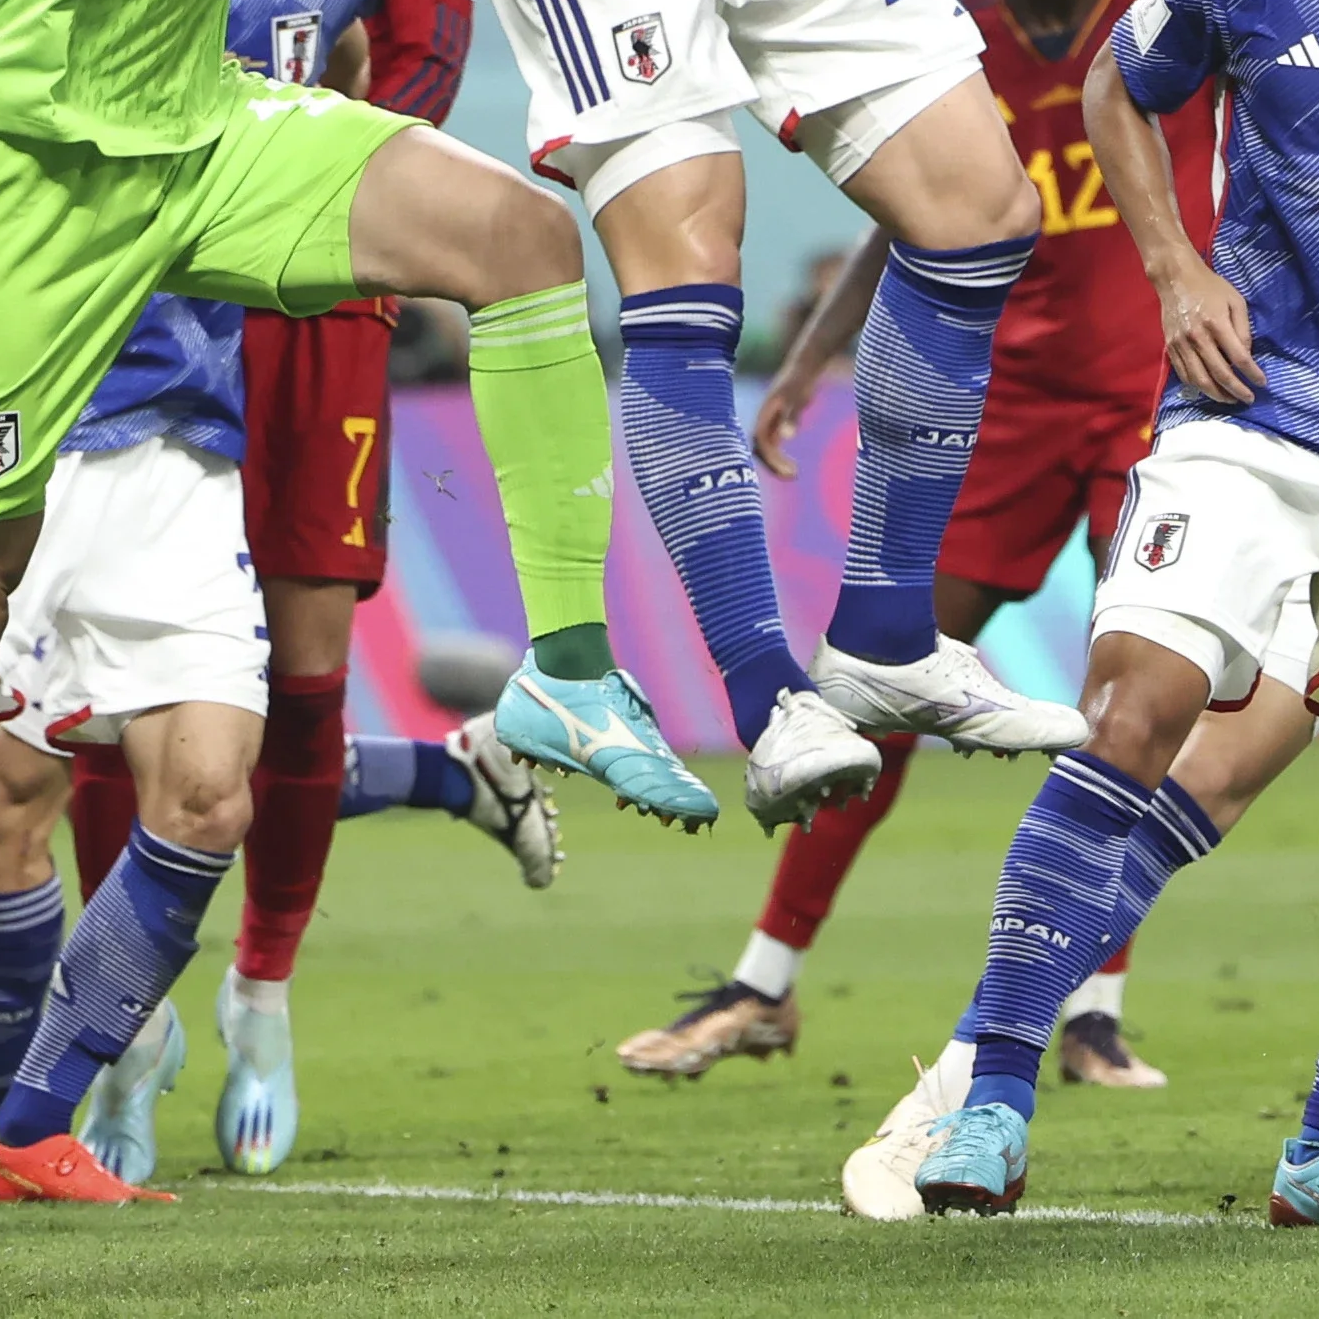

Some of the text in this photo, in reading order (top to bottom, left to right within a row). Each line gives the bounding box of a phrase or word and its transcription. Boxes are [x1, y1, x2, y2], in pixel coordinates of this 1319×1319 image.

[1026, 140, 1121, 237] 12
[342, 416, 377, 509] 7
[989, 916, 1072, 950] APAN
